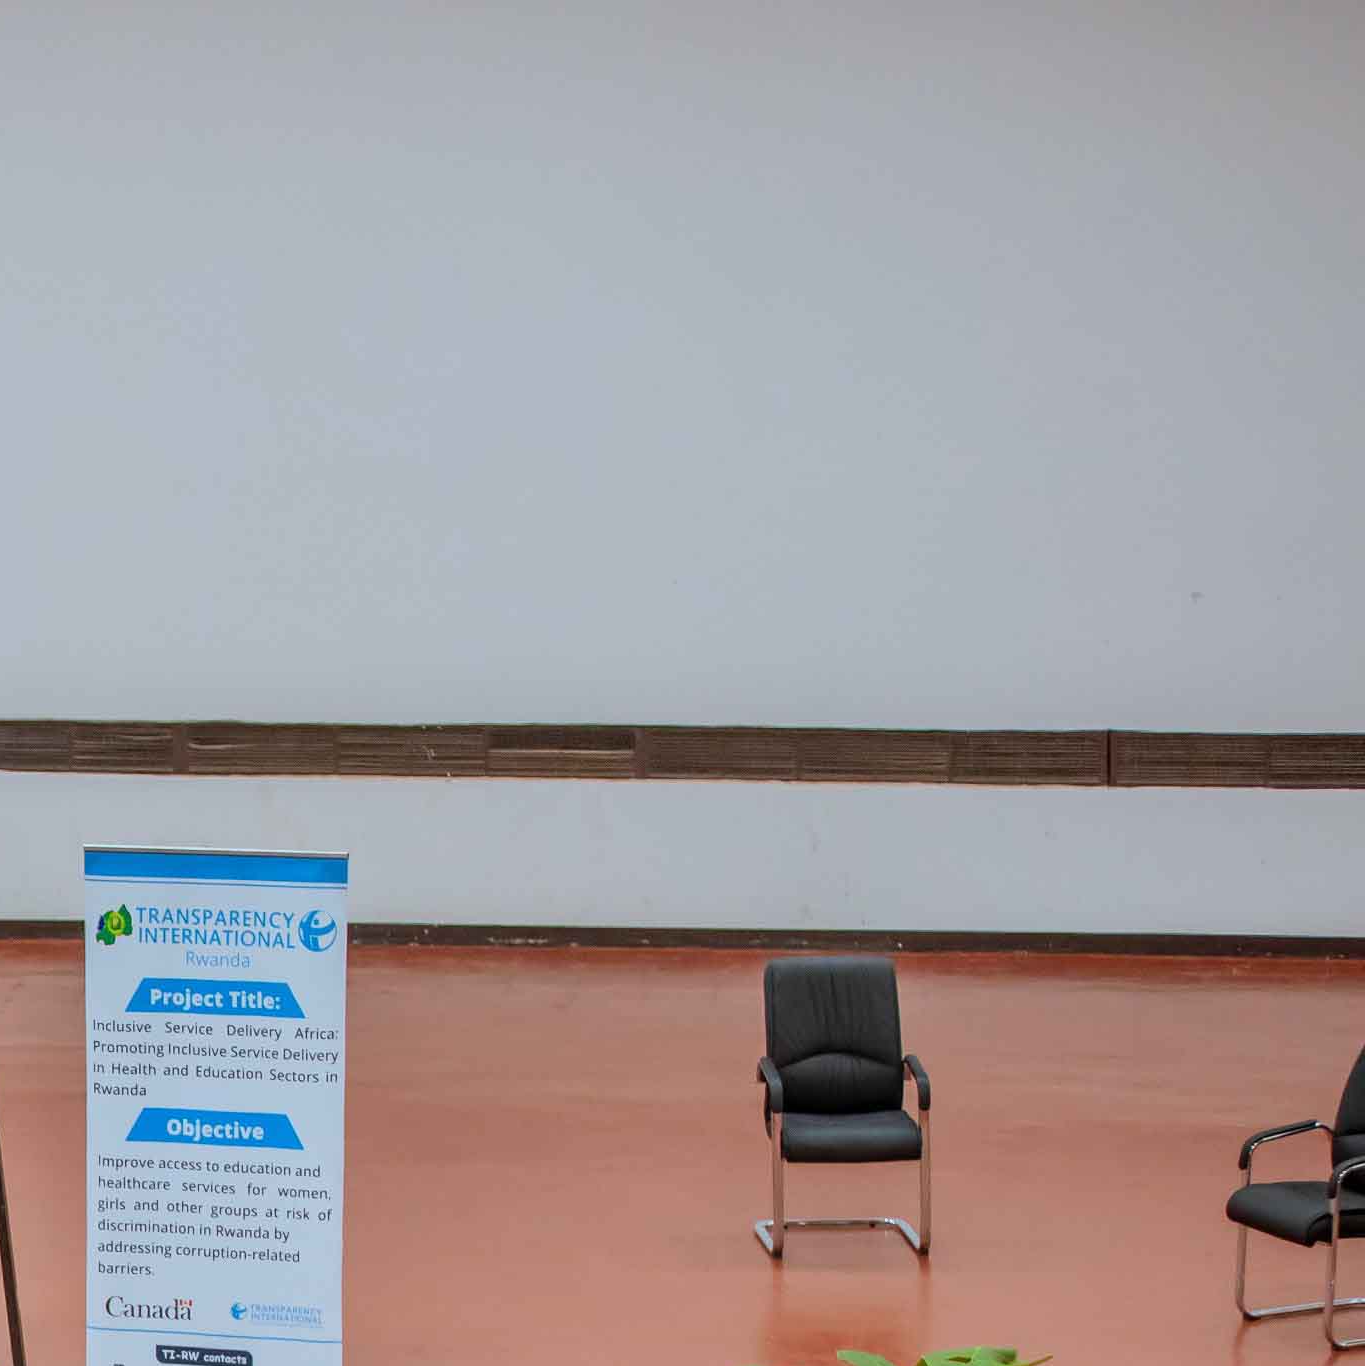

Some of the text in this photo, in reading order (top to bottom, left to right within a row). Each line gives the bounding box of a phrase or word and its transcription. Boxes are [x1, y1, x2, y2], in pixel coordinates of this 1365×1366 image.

[136, 907, 295, 929] TRANSPARENCY
[138, 927, 296, 949] INTERNATIONAL
[186, 951, 251, 968] Rwanda
[150, 988, 281, 1010] Project Title:
[93, 1020, 339, 1041] Inclusive Service Delivery Africa:
[93, 1040, 339, 1065] Promoting Inclusive Service Delivery
[93, 1063, 338, 1083] in Health and Education Sectors in
[93, 1083, 147, 1097] Rwanda
[167, 1119, 264, 1140] Objective
[98, 1155, 321, 1178] Improve access to education and
[98, 1176, 331, 1201] healthcare services for women,
[98, 1198, 332, 1222] girls and other groups at risk of
[98, 1219, 290, 1244] discrimination in Rwanda by
[98, 1240, 300, 1263] addressing corruption-related
[98, 1261, 155, 1276] barriers.
[105, 1296, 192, 1320] Canada
[161, 1349, 247, 1365] TI-RW contacts
